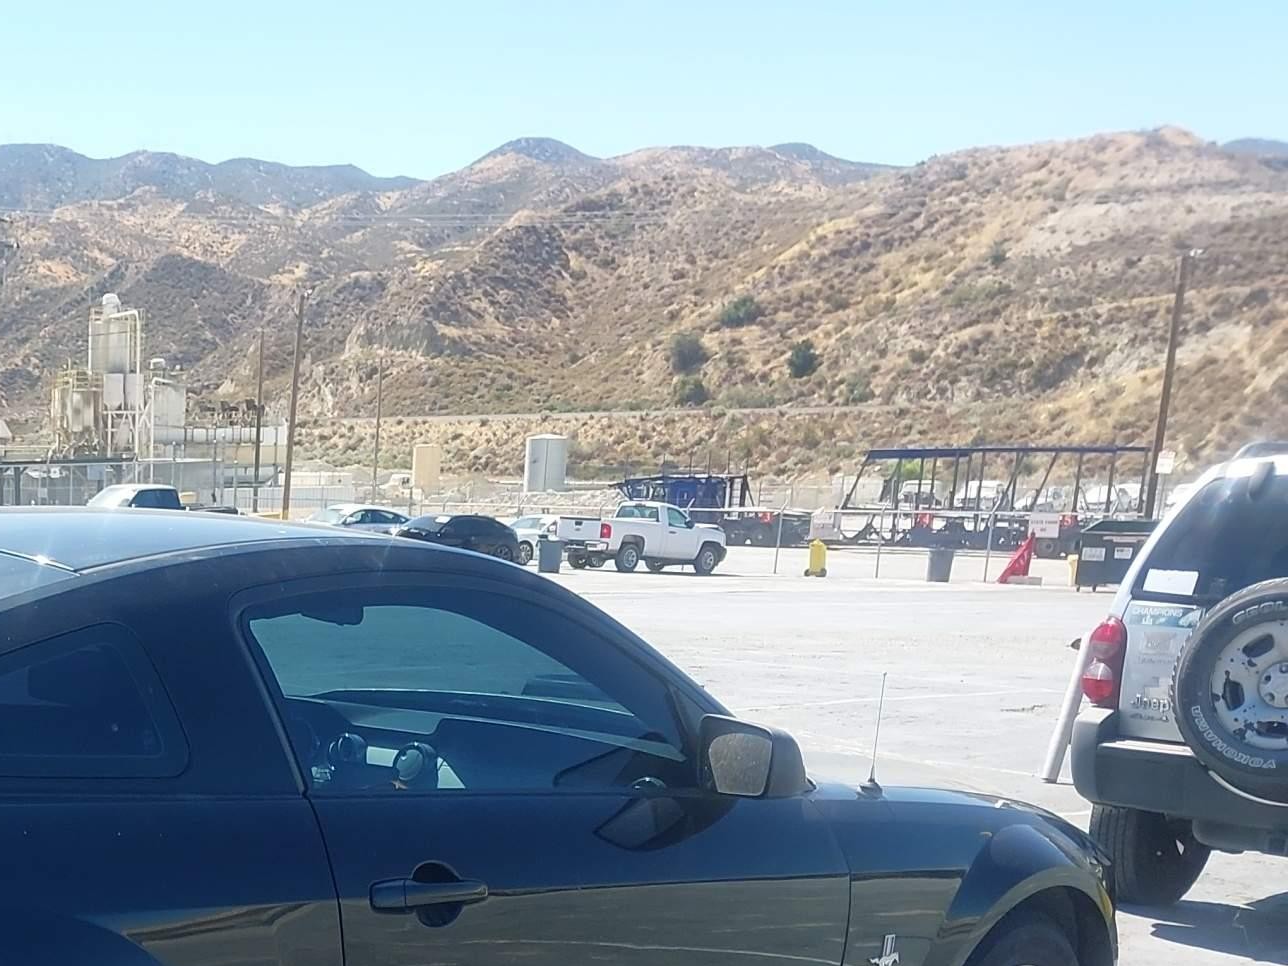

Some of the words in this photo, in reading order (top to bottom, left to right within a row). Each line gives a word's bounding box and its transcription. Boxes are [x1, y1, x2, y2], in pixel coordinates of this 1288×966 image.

[1132, 607, 1184, 618] CHAMPIONS
[1130, 693, 1170, 713] Jeep
[1192, 705, 1276, 768] YOKOHAMA
